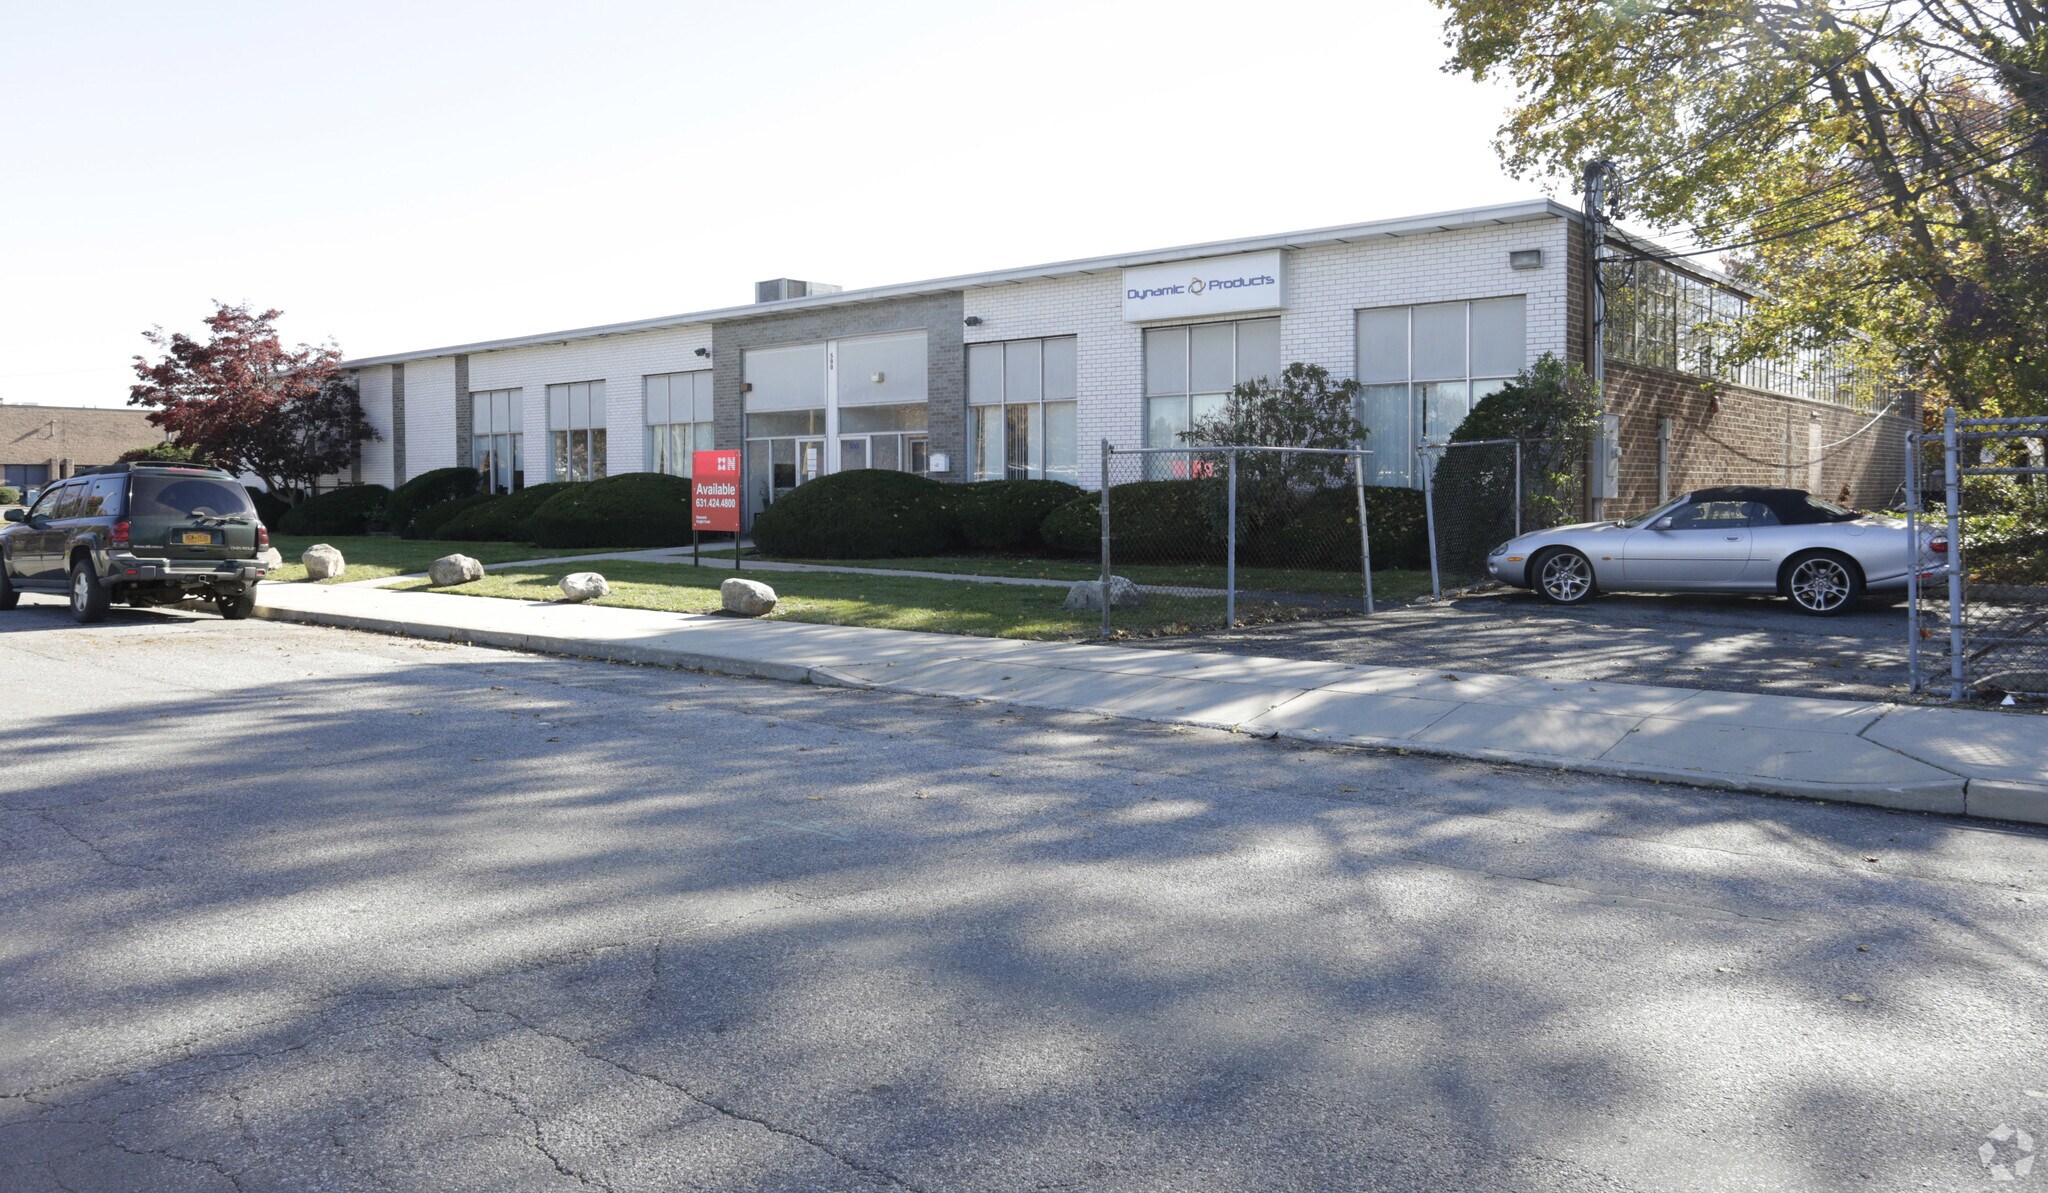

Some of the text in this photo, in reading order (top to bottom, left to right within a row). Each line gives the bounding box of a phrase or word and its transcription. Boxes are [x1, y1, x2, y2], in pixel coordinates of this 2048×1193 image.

[1127, 274, 1275, 300] Dynamic Products
[696, 483, 736, 496] Available
[695, 498, 736, 509] 631.424.4800
